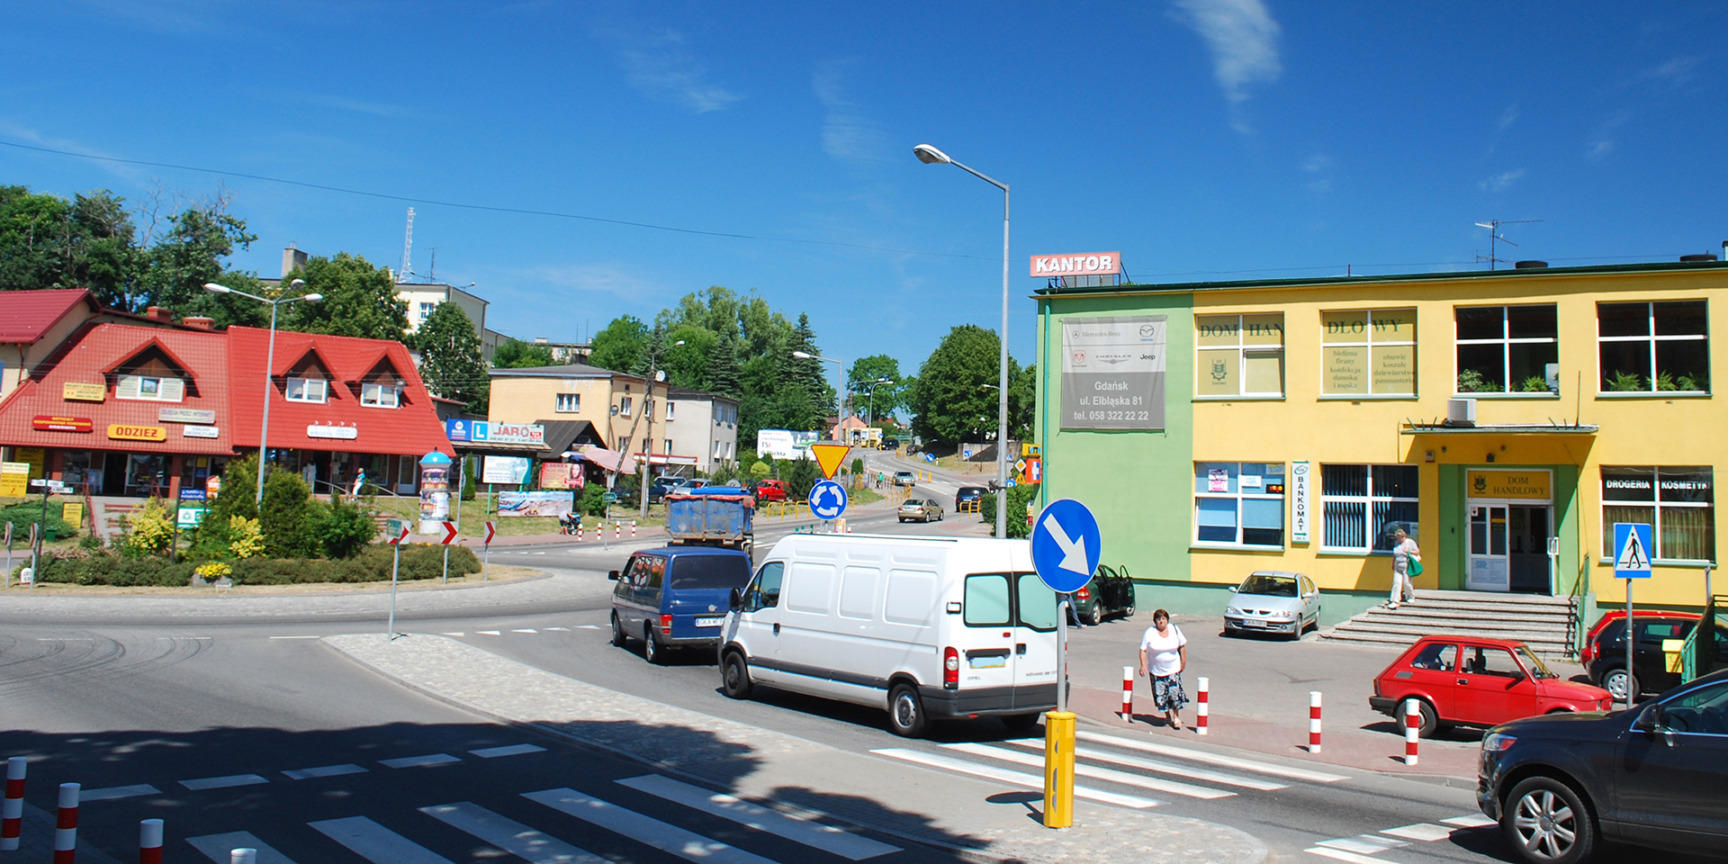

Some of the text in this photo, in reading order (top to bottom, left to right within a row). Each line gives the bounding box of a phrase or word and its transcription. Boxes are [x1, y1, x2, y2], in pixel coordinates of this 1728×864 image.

[1036, 255, 1113, 273] KANTOR
[1200, 323, 1239, 337] DOM
[1140, 353, 1156, 361] Jeep
[1094, 381, 1129, 391] Gdańsk
[1080, 396, 1143, 407] ul. Elbląska 81
[1073, 410, 1149, 420] tel. 058 322 22 22
[476, 425, 485, 439] L
[1508, 476, 1529, 484] DOM
[1606, 480, 1711, 490] DROGERIA KOSMETYKI
[1493, 486, 1546, 495] HANDLOWY
[1297, 476, 1305, 531] BANKOMAT
